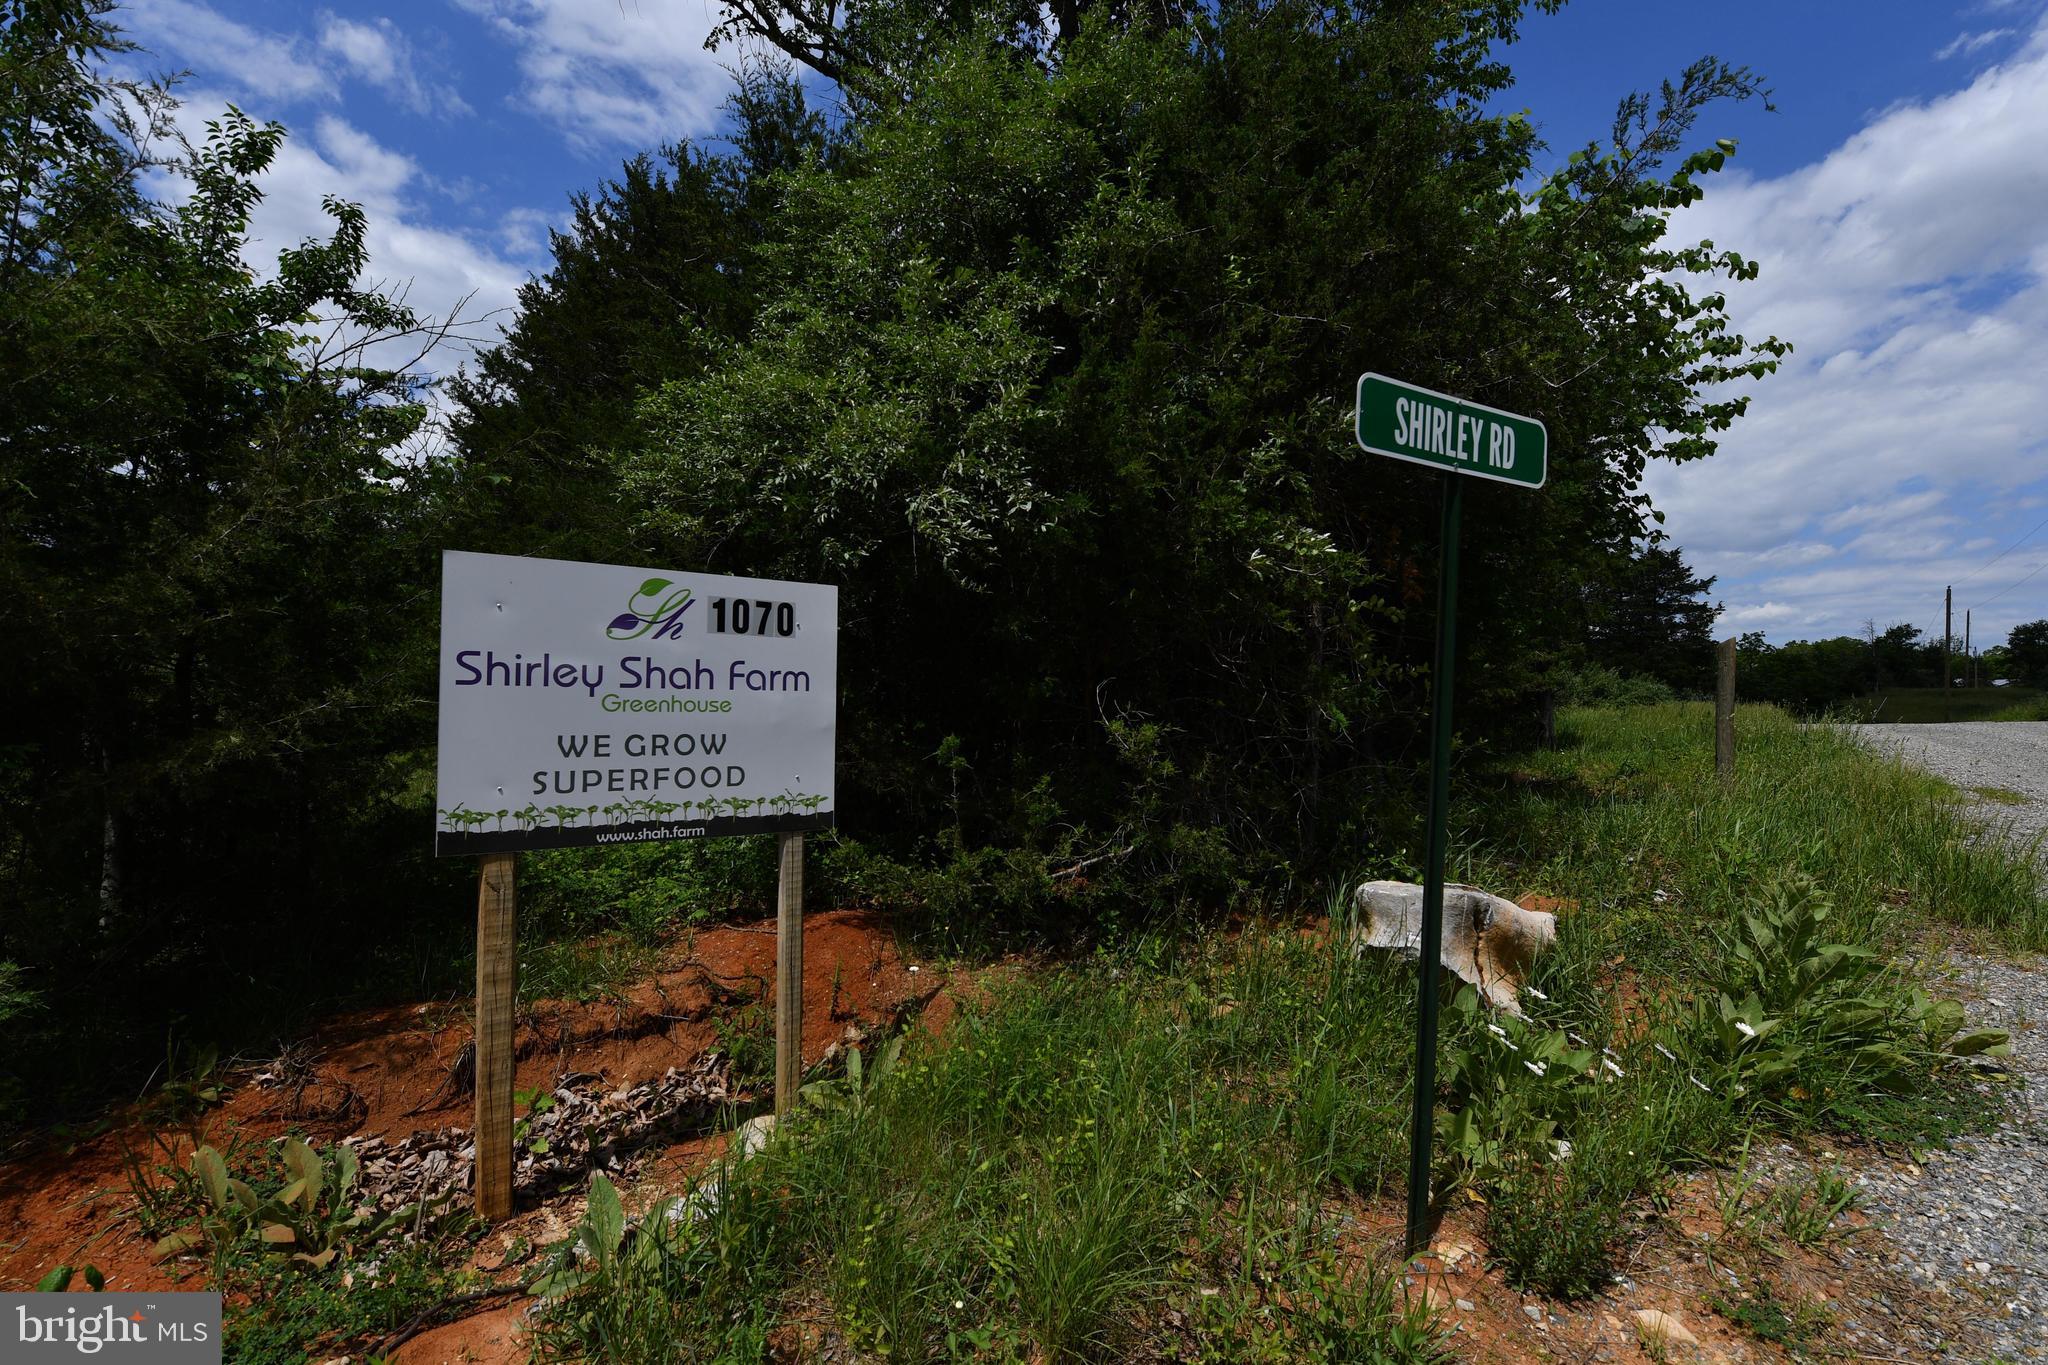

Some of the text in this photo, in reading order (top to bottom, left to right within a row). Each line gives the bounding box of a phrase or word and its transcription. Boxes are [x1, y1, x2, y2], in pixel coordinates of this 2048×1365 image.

[1394, 396, 1516, 470] SHIRLEY RD
[711, 597, 795, 637] 1070
[455, 650, 810, 697] Shirley Shah Farm
[601, 693, 732, 713] Greenhouse
[557, 733, 727, 758] WE GROW
[533, 765, 746, 795] SUPERFOOD
[596, 825, 705, 843] www.shah.farm
